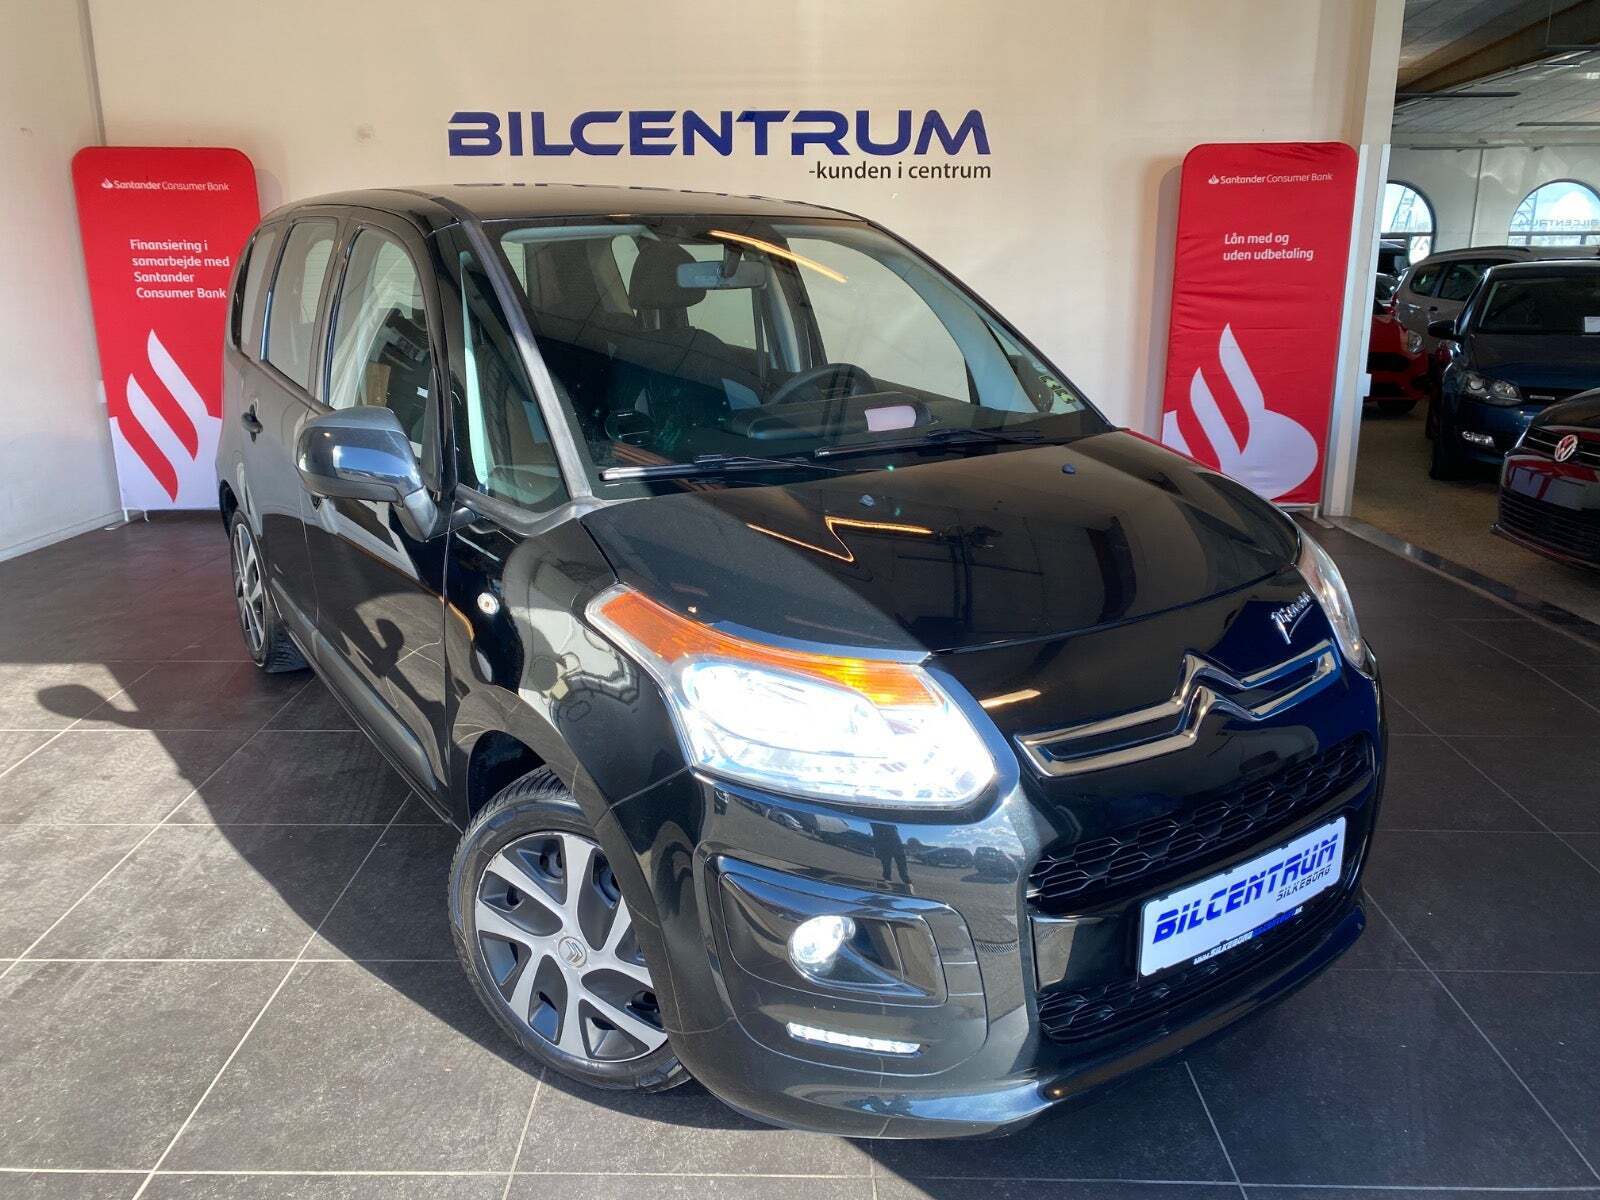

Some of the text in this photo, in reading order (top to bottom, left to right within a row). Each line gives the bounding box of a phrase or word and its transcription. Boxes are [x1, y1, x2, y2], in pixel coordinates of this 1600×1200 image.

[448, 109, 992, 157] BILCENTRUM
[808, 161, 992, 180] -kunden i centrum
[113, 179, 230, 191] Santander Consumer Bank
[1220, 173, 1334, 185] Santander Consumer Bank
[1224, 232, 1290, 246] Lån med og
[129, 239, 209, 254] Finansiering i
[1223, 247, 1314, 262] uden udbetaling
[131, 255, 230, 269] samarbejde med
[134, 271, 195, 283] Santander
[136, 287, 227, 299] Consumer Bank
[1153, 833, 1339, 945] BILCENTRUM
